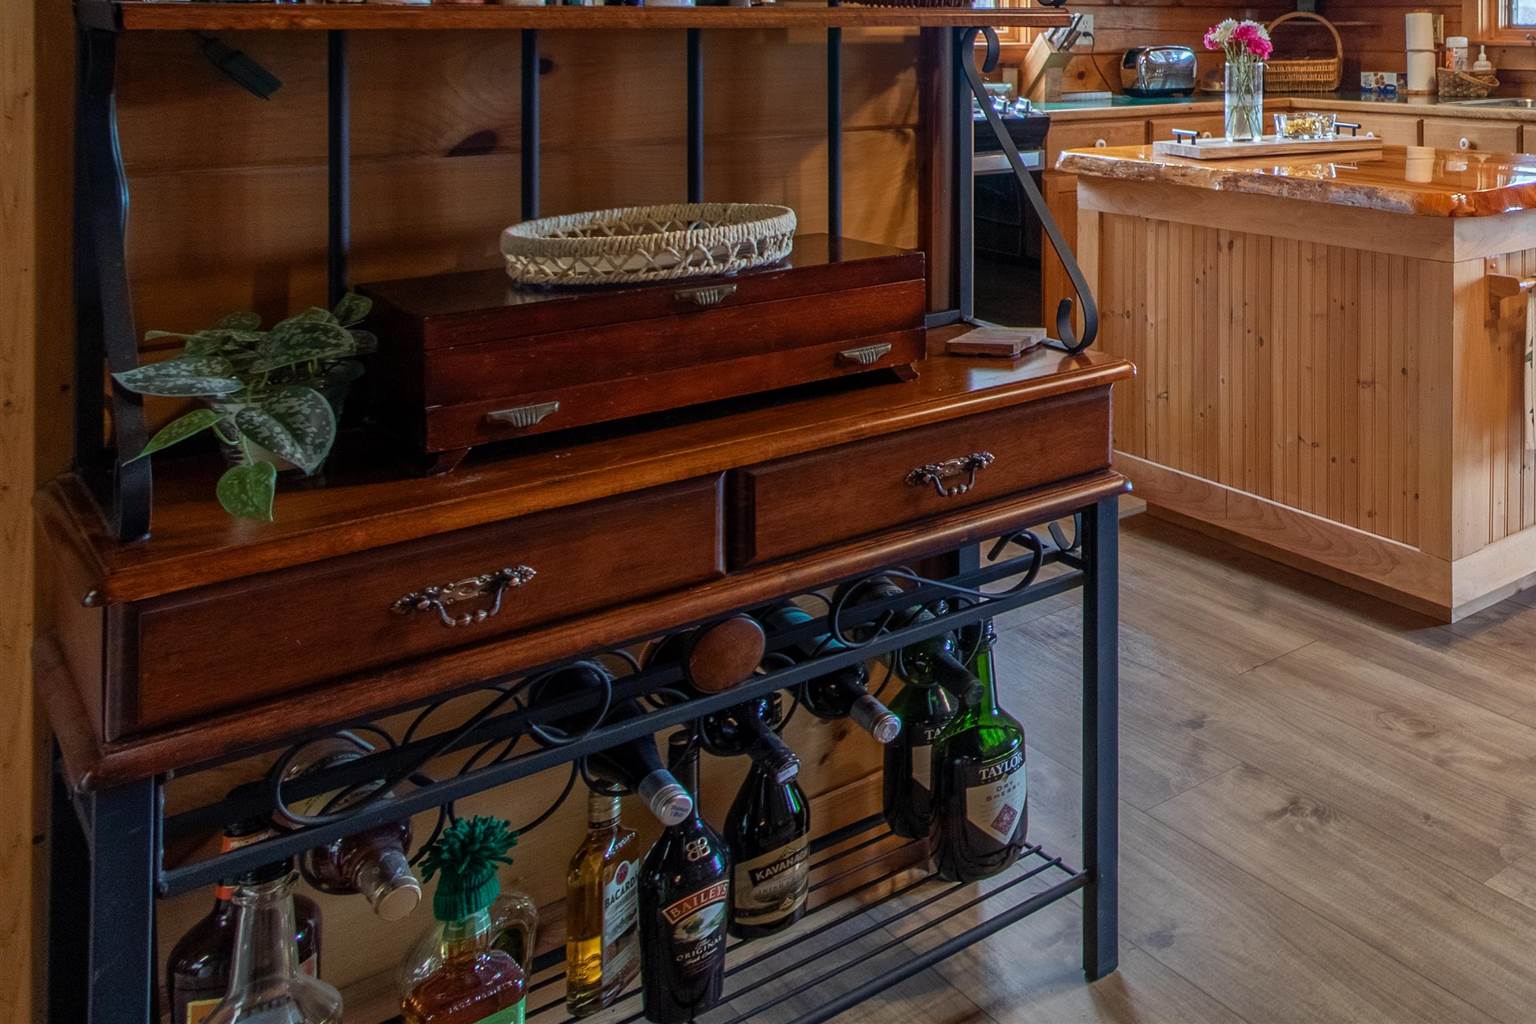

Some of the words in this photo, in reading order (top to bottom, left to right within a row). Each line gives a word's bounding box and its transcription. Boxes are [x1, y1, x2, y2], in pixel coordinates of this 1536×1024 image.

[978, 751, 1024, 781] TAYLOR
[670, 881, 728, 917] BAILEYS
[676, 934, 723, 962] ORIGINAL
